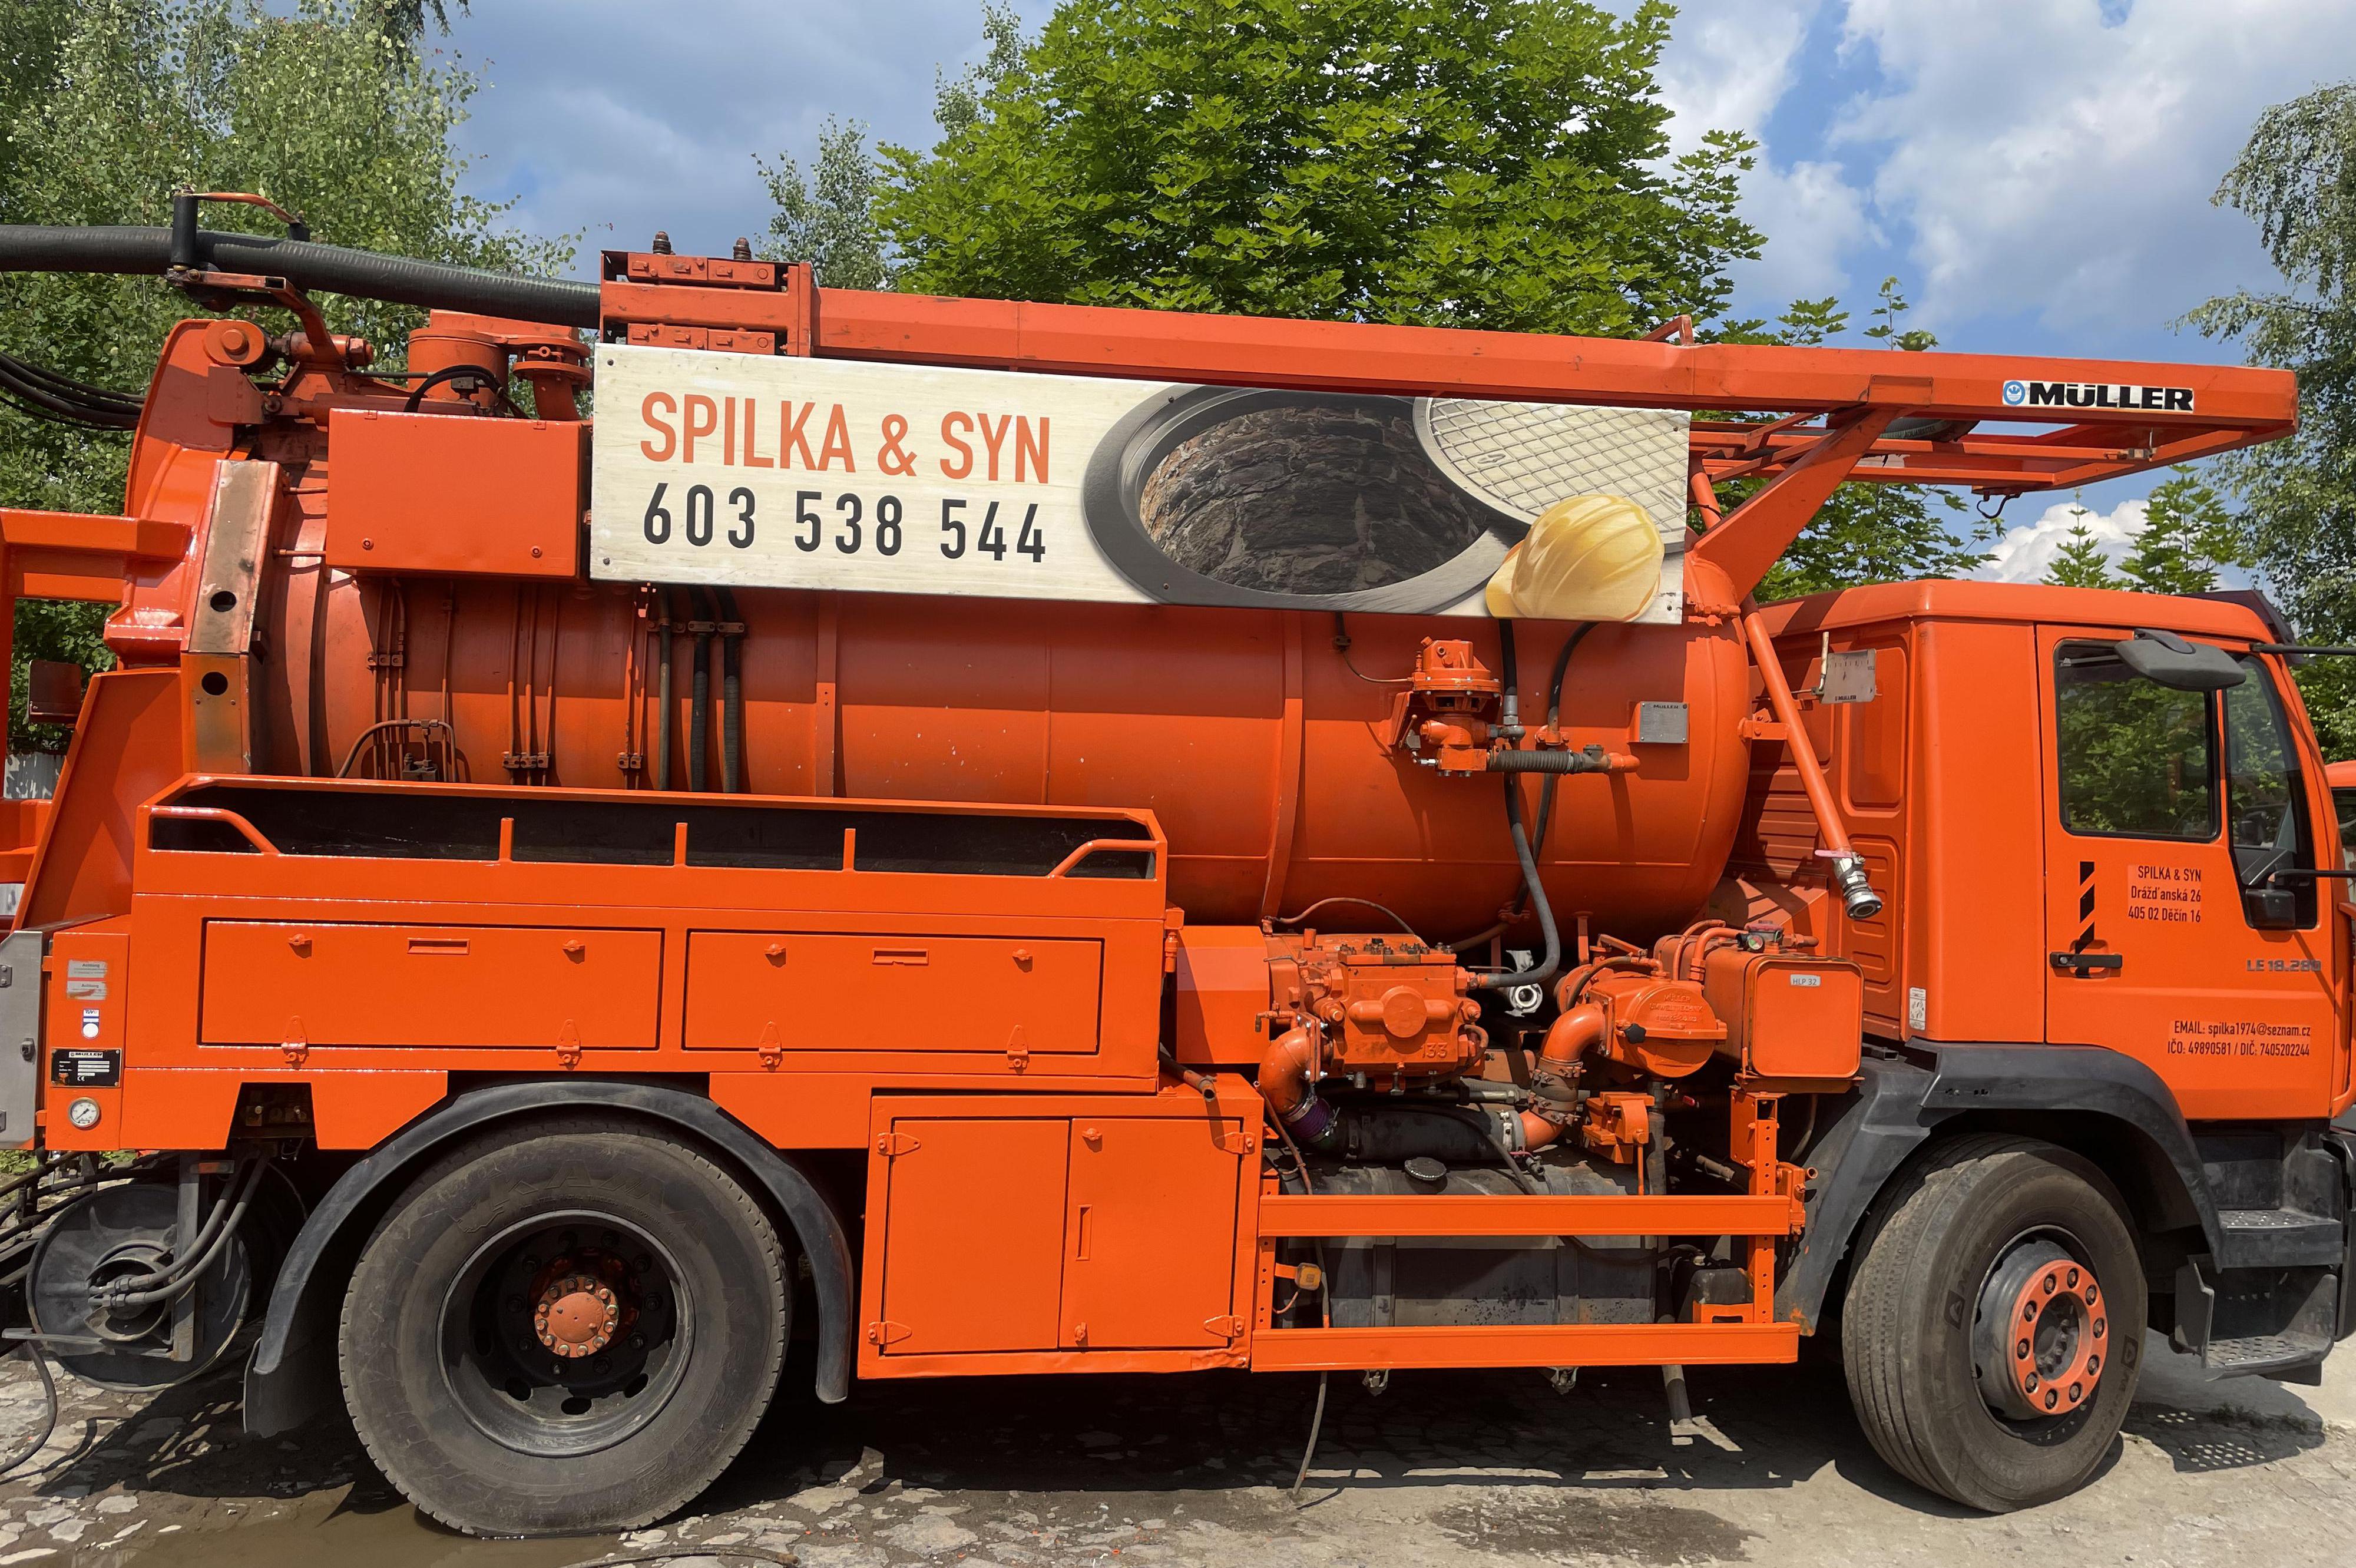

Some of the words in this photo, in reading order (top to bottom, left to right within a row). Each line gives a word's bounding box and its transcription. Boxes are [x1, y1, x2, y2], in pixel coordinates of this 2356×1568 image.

[2029, 382, 2193, 411] MÜLLER
[640, 391, 857, 473] SPILKA
[877, 413, 918, 478] &
[939, 411, 1050, 485] SYN
[644, 482, 756, 550] 603
[794, 490, 903, 556] 538
[941, 499, 1047, 563] 544
[2138, 865, 2171, 880] SPILKA
[2173, 869, 2180, 881] &
[2183, 868, 2201, 882] SYN
[2190, 889, 2201, 902] 26
[2128, 905, 2145, 919] 405
[2148, 907, 2159, 920] 02
[2162, 908, 2187, 922] Děčín
[2190, 909, 2201, 922] 16
[2246, 960, 2264, 971] LE
[2174, 1020, 2205, 1034] EMAIL:
[2208, 1021, 2311, 1038] spilka1974@seznam.cz
[2168, 1038, 2185, 1054] IČO:
[2188, 1040, 2231, 1055] 49890581
[2233, 1041, 2239, 1055] /
[2241, 1040, 2257, 1056] DIČ:
[2260, 1043, 2309, 1057] 7405202244
